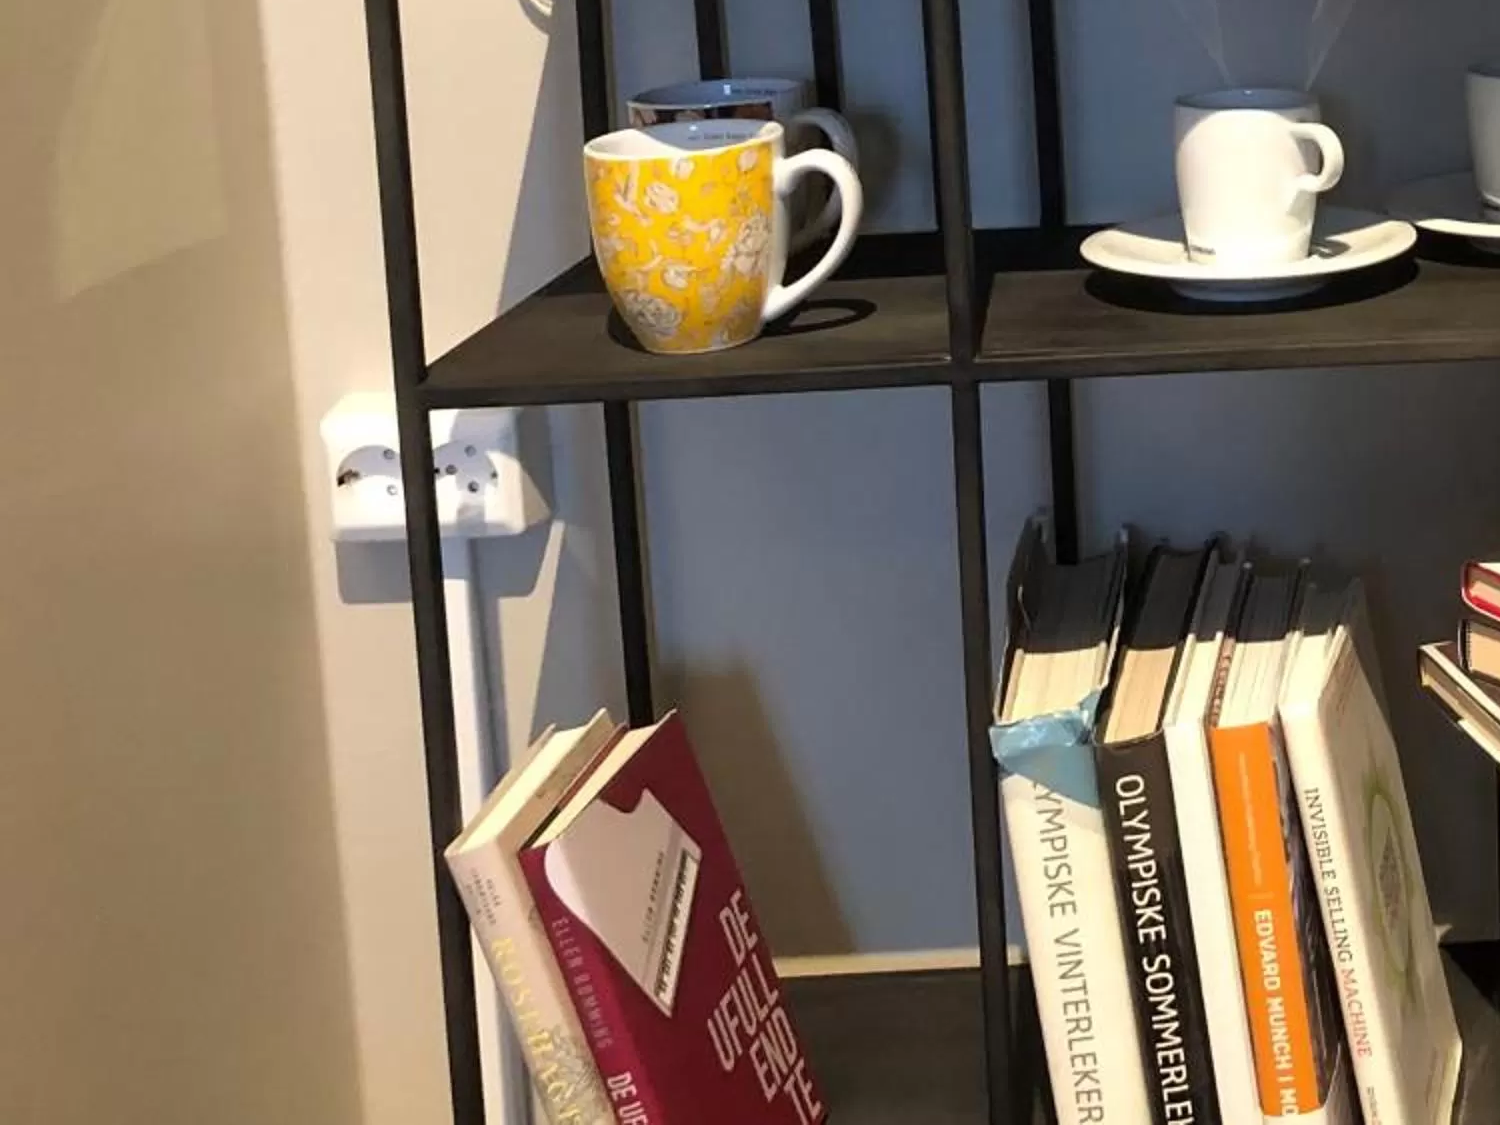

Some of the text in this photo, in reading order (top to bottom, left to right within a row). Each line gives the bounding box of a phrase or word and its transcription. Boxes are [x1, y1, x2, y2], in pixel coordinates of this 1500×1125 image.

[719, 888, 759, 967] DE
[1033, 781, 1105, 1125] YMPISKE VINTERLEKER
[1115, 774, 1195, 1125] OLYMPISKE SOMMERLE
[1254, 909, 1281, 990] EDVARD
[1304, 787, 1373, 1057] INVISIBLE SELLING MACHINE
[707, 952, 779, 1072] UFULL
[750, 1006, 798, 1103] END
[1265, 996, 1293, 1070] MUNCH
[608, 1071, 637, 1100] DE
